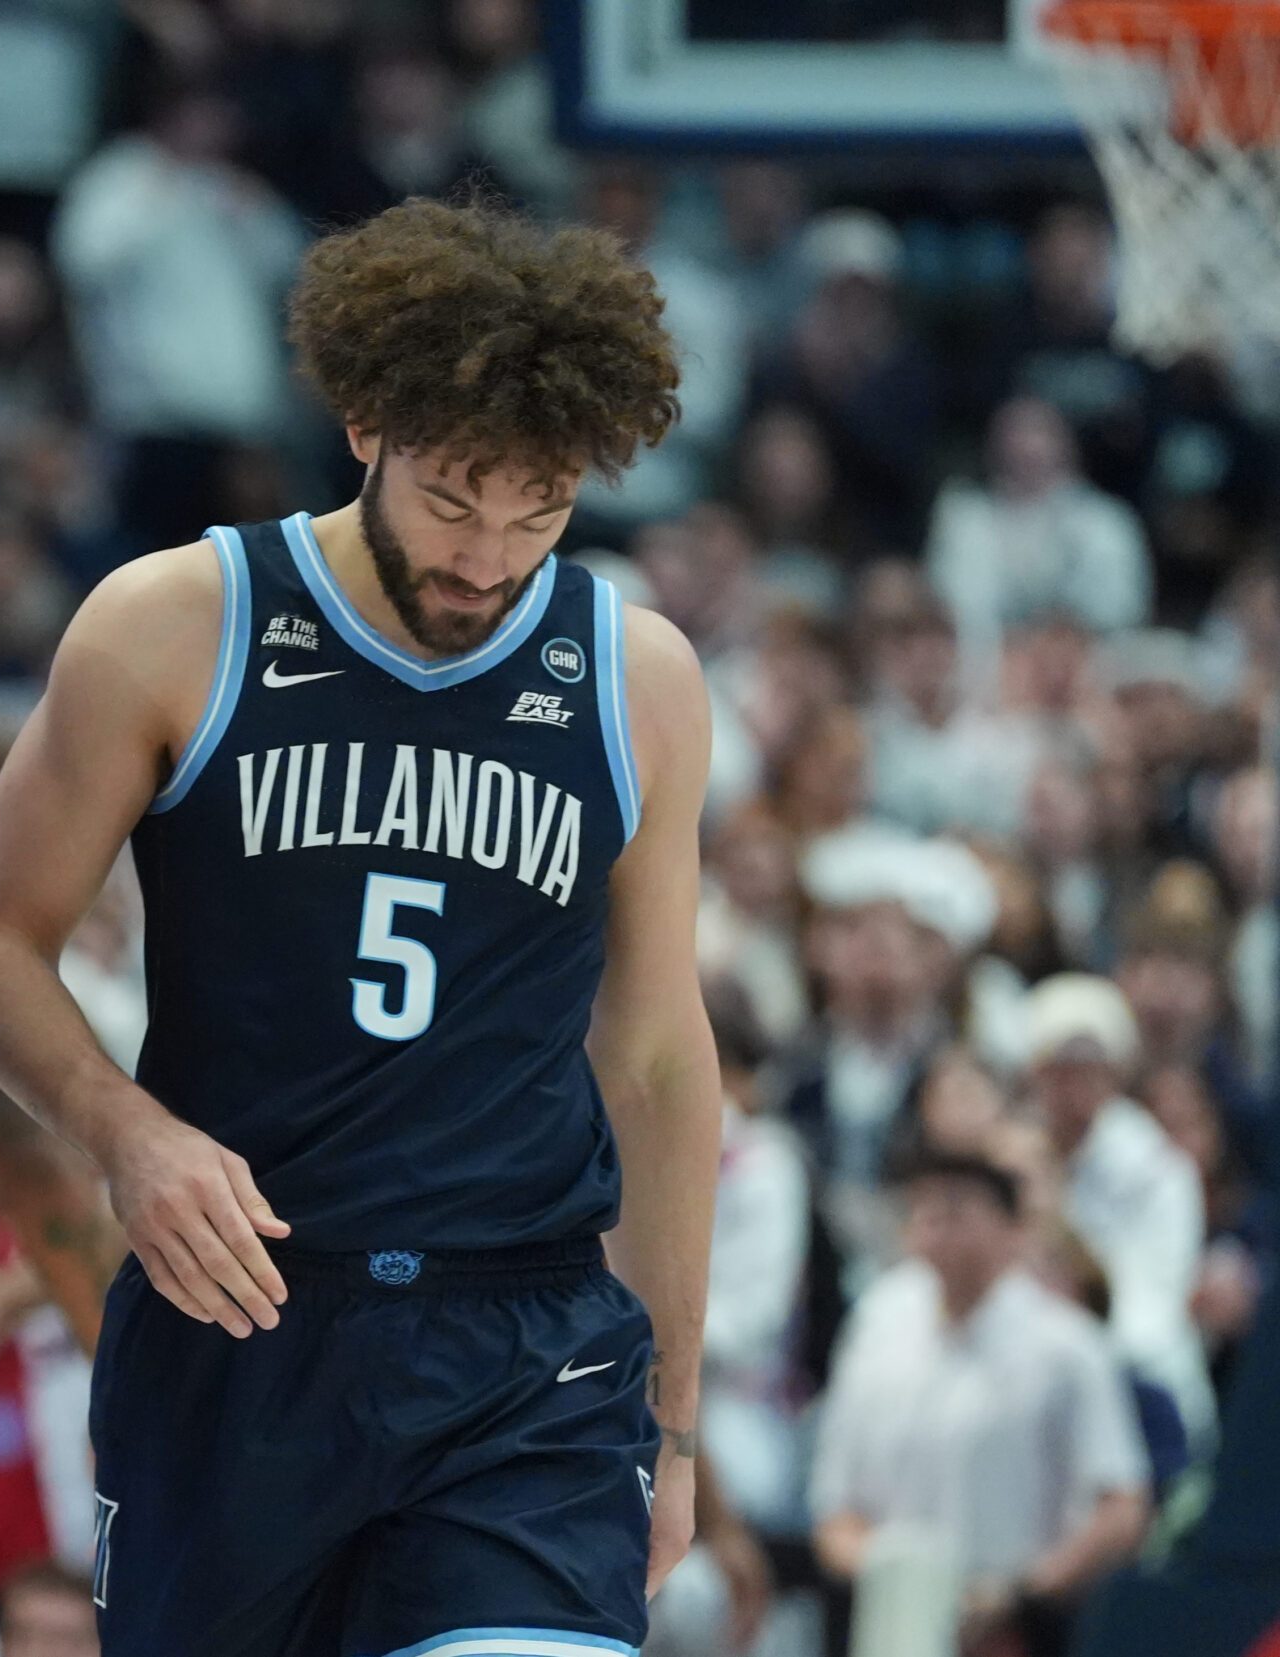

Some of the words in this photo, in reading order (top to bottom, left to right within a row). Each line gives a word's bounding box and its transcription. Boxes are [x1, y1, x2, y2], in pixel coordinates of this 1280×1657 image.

[268, 616, 290, 631] BE
[292, 618, 319, 636] THE
[261, 630, 320, 650] CHANGE
[549, 649, 579, 671] GHR
[517, 691, 563, 709] BIG
[509, 703, 575, 722] EAST
[237, 742, 583, 907] VILLANOVA
[348, 872, 447, 1042] 5
